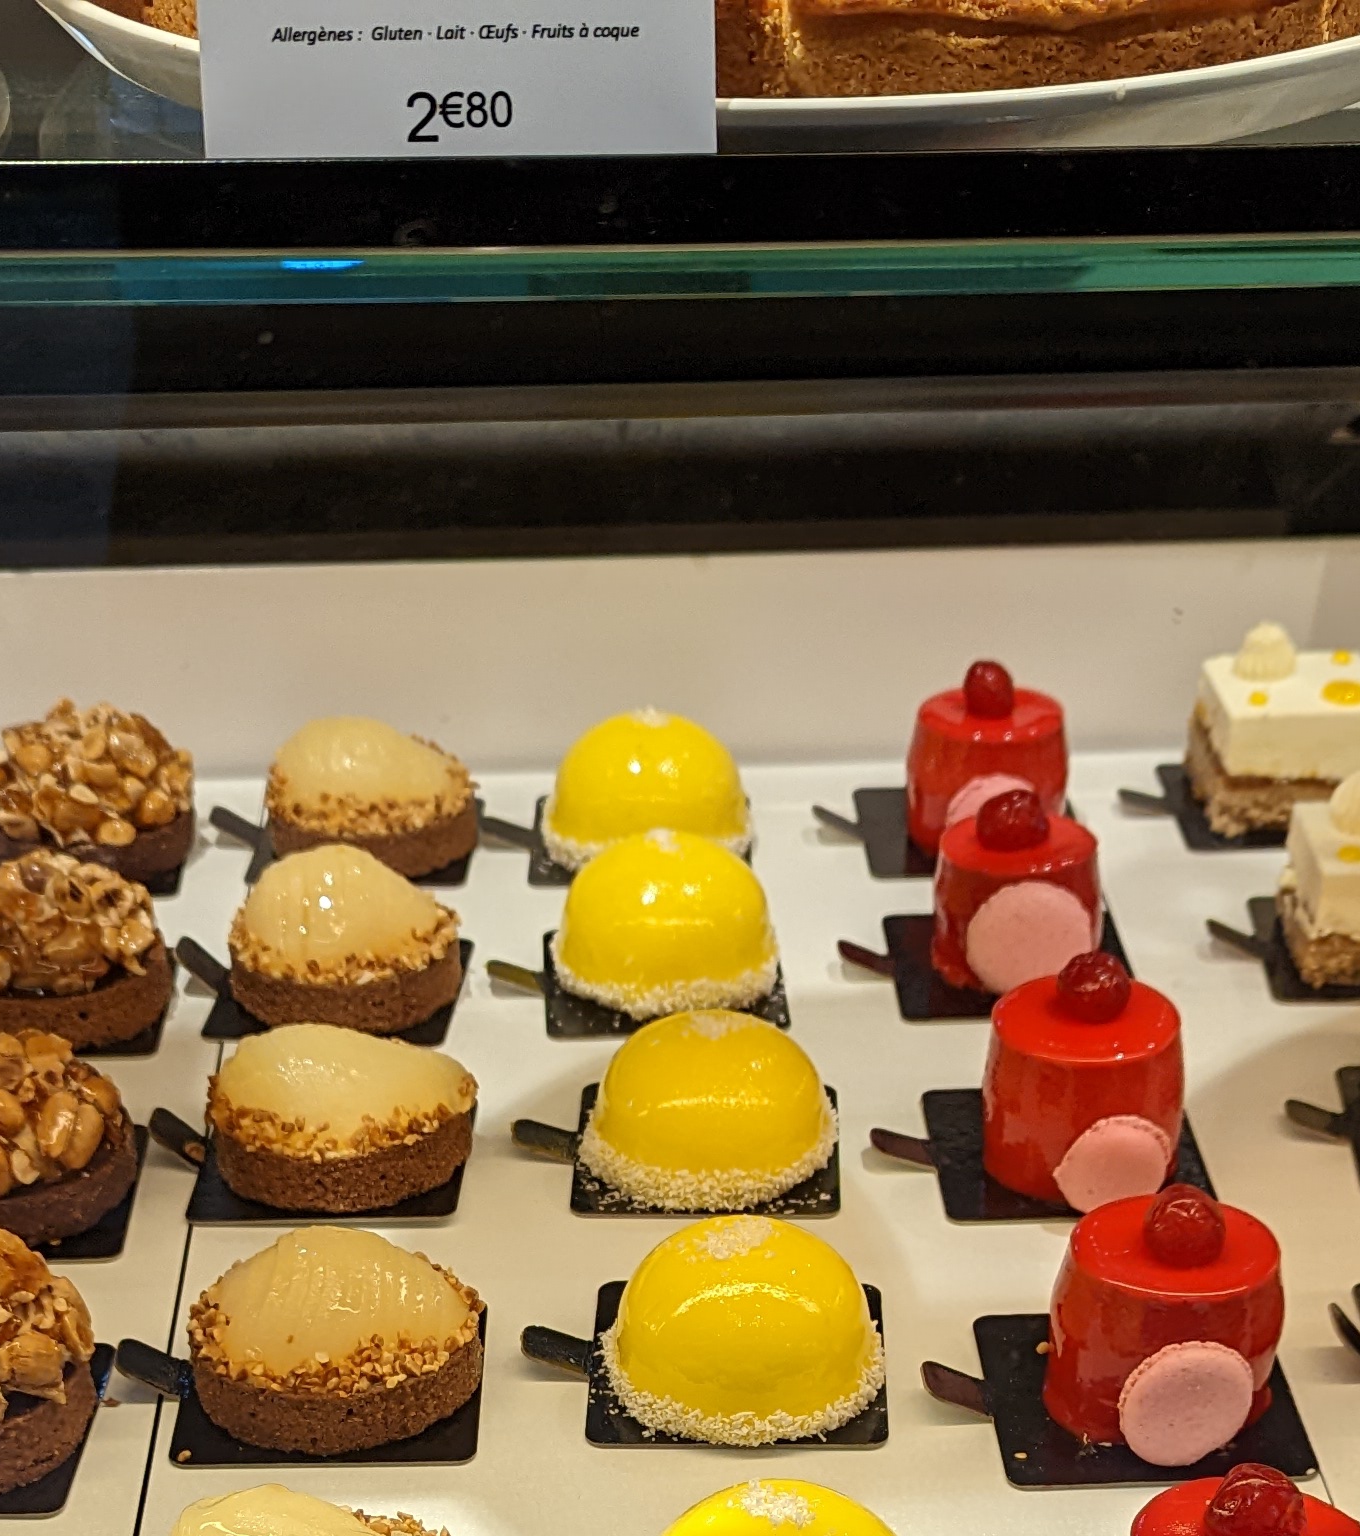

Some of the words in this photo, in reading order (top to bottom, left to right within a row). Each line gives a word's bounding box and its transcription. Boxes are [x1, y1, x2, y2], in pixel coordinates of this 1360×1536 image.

[272, 27, 353, 45] Allergènes
[372, 26, 422, 41] Gluten
[436, 25, 466, 40] Lait
[532, 24, 574, 38] Fruits
[579, 23, 589, 38] à
[593, 26, 639, 41] coque
[407, 91, 512, 142] 2€80
